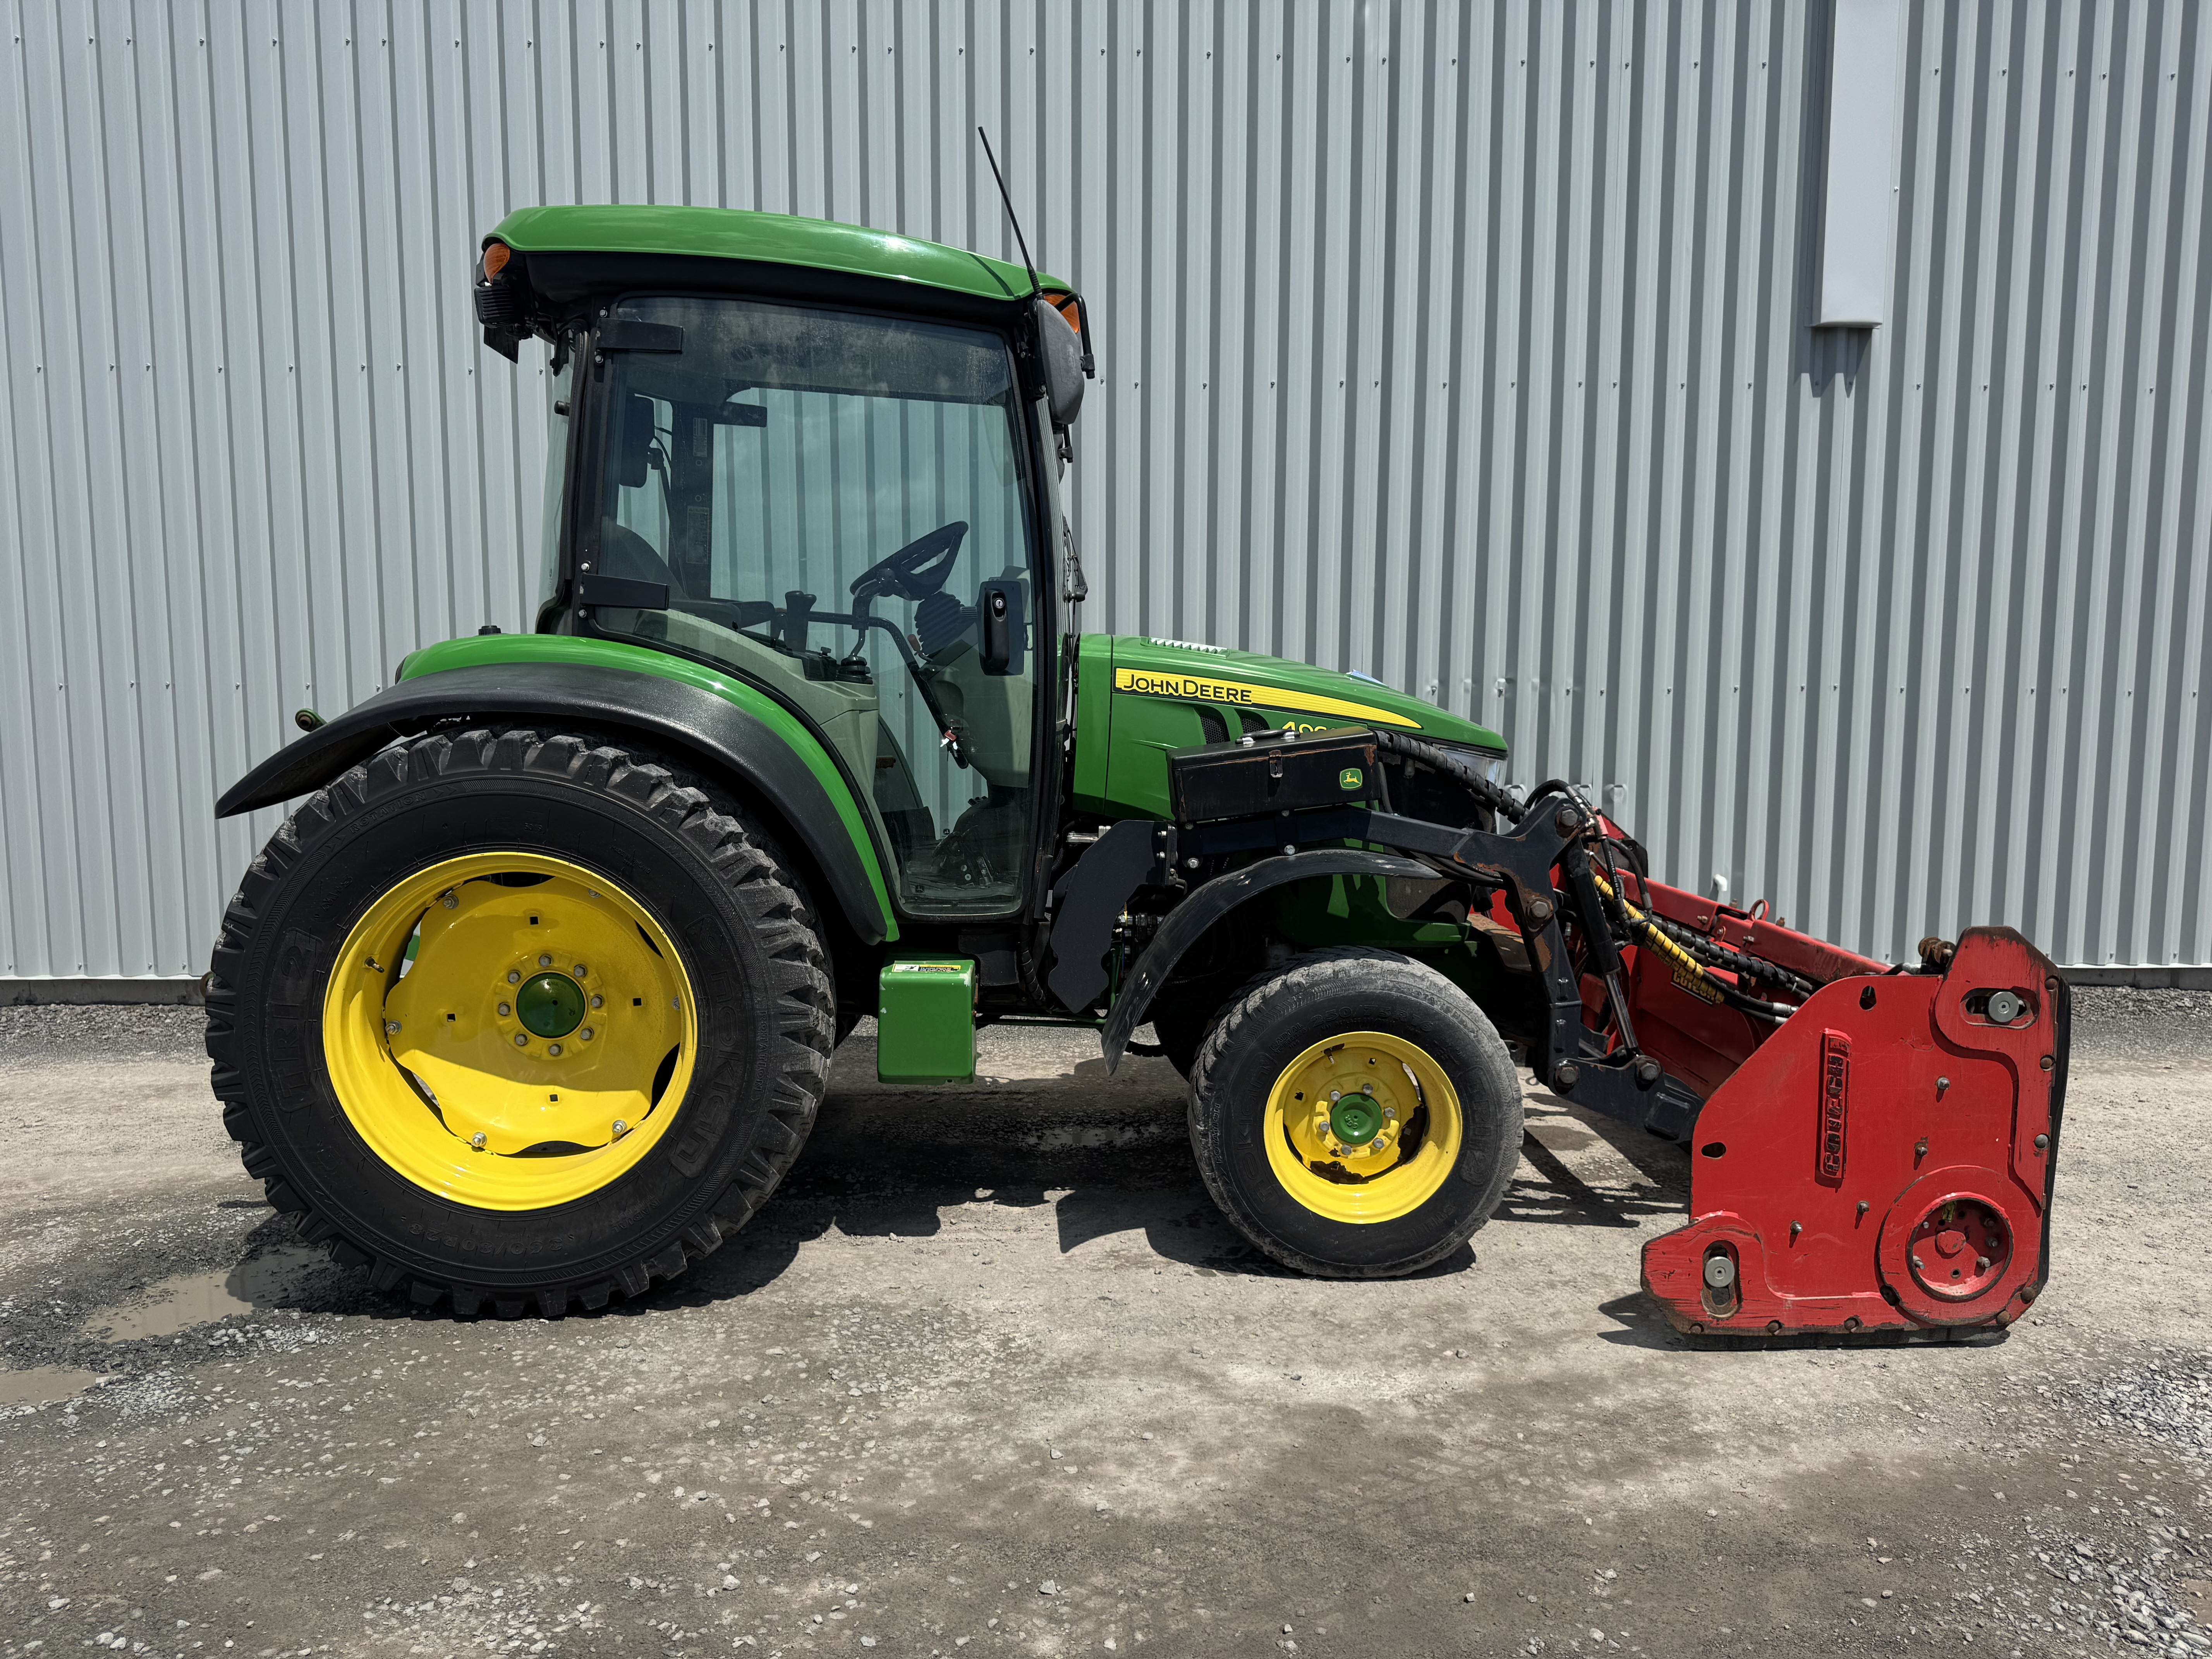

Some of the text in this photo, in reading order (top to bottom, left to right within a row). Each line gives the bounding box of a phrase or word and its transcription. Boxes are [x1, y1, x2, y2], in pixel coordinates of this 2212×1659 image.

[1124, 674, 1252, 702] JOHN DEERE
[349, 792, 427, 834] ROTATION
[272, 945, 308, 1097] TRI 2
[1269, 1023, 1303, 1050] RADIAL
[752, 1009, 768, 1095] ROTATION
[611, 1197, 661, 1233] RADIAL
[335, 1211, 409, 1260] ROTATION
[408, 1221, 564, 1256] 360/80R28
